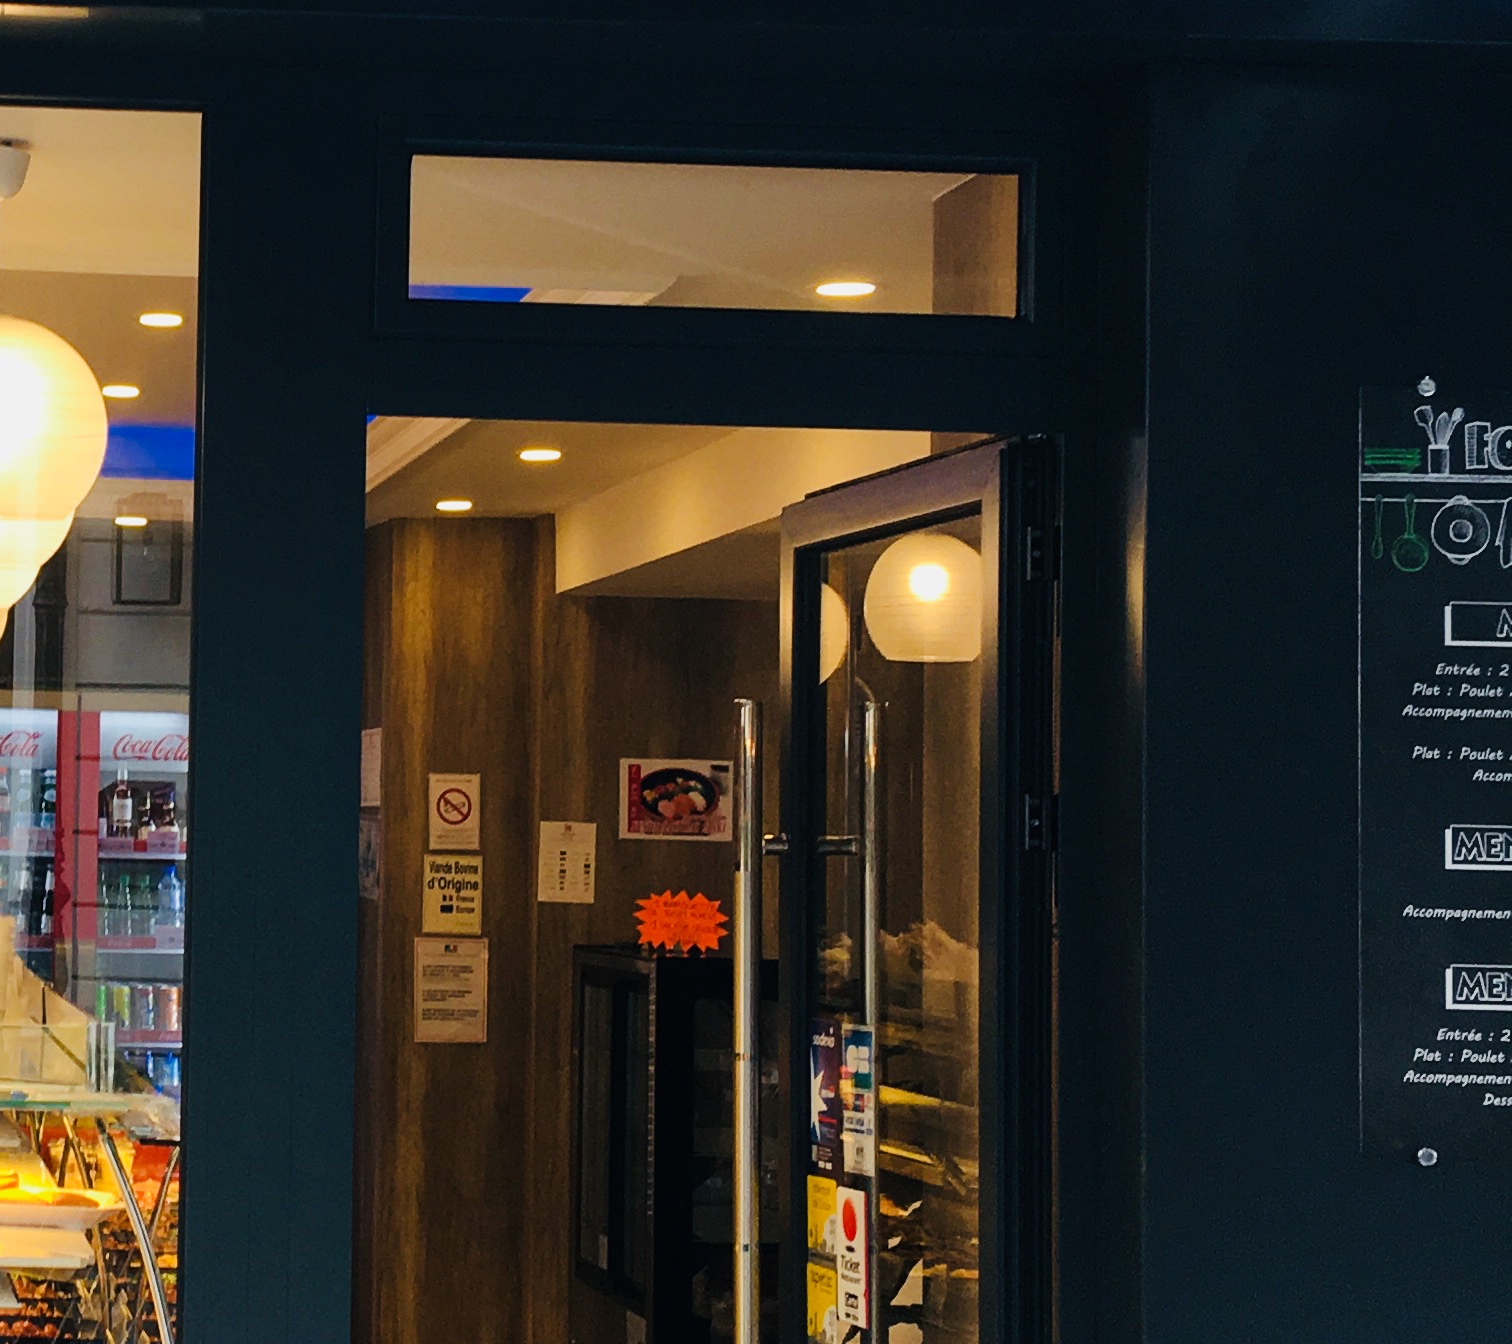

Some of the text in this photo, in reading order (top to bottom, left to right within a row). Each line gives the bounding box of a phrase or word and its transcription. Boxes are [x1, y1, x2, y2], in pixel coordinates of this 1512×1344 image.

[1435, 663, 1481, 675] Entrée
[1499, 663, 1510, 677] 2
[1412, 682, 1441, 696] Plat
[1459, 683, 1503, 697] Poulet
[1412, 745, 1441, 759] Plat
[1459, 746, 1504, 760] Poulet
[427, 876, 480, 893] d'Origine
[1436, 1028, 1482, 1041] Entrée
[1500, 1029, 1511, 1042] 2
[1413, 1047, 1441, 1062] Plat
[1460, 1049, 1505, 1064] Poulet
[841, 1254, 861, 1274] Ticket
